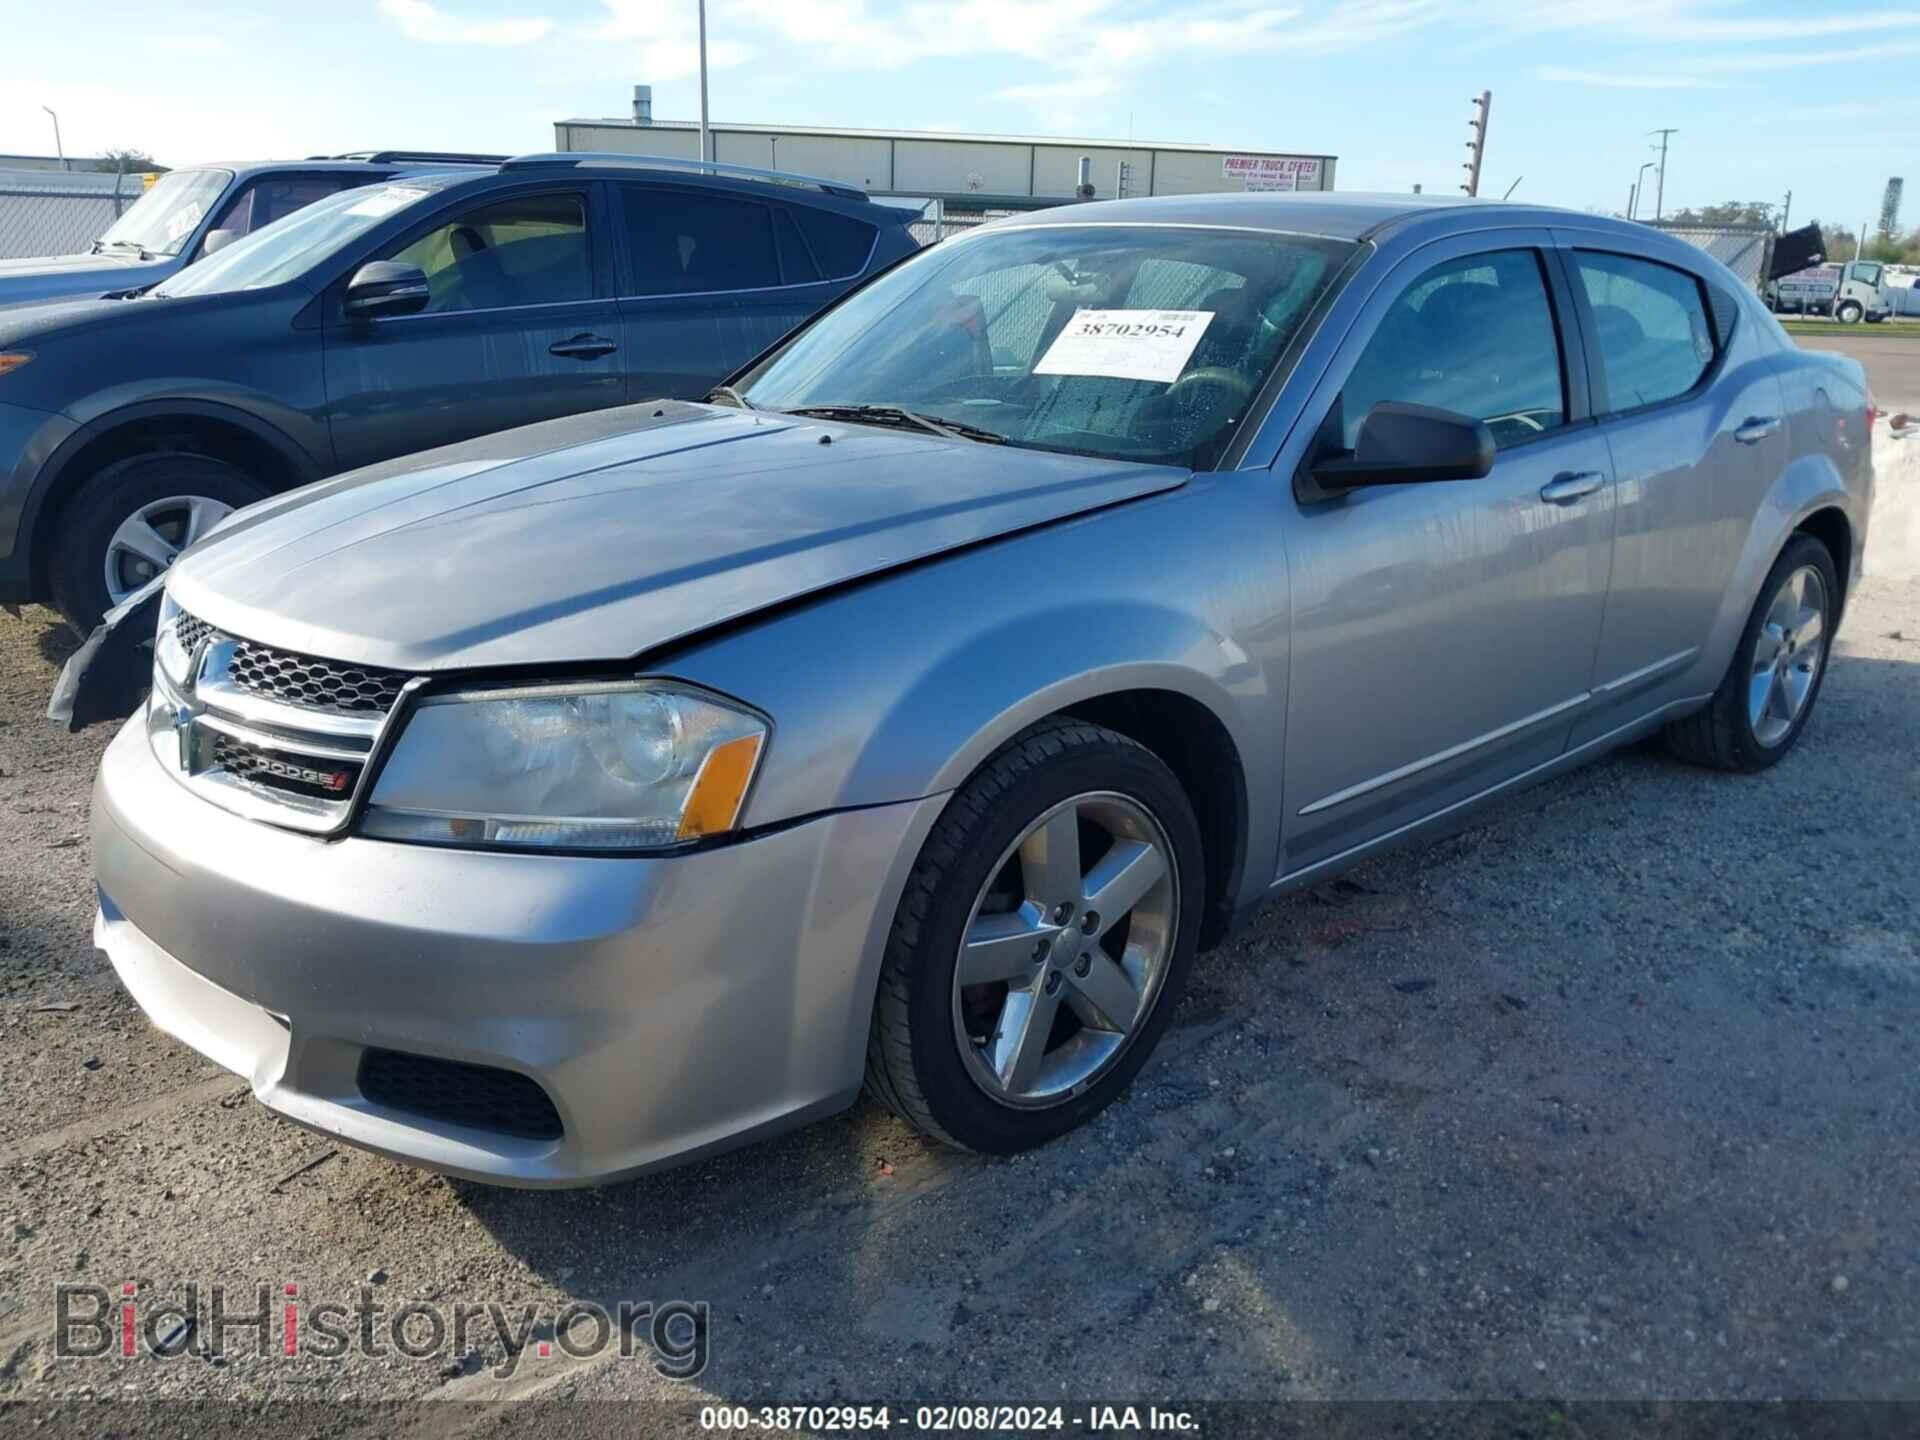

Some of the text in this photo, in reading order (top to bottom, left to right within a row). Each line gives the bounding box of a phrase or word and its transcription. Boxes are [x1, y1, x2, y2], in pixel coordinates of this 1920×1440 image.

[1224, 158, 1317, 173] PREMIER TRUCK CENTER
[1075, 323, 1187, 339] 38702954
[256, 757, 336, 785] DODGE
